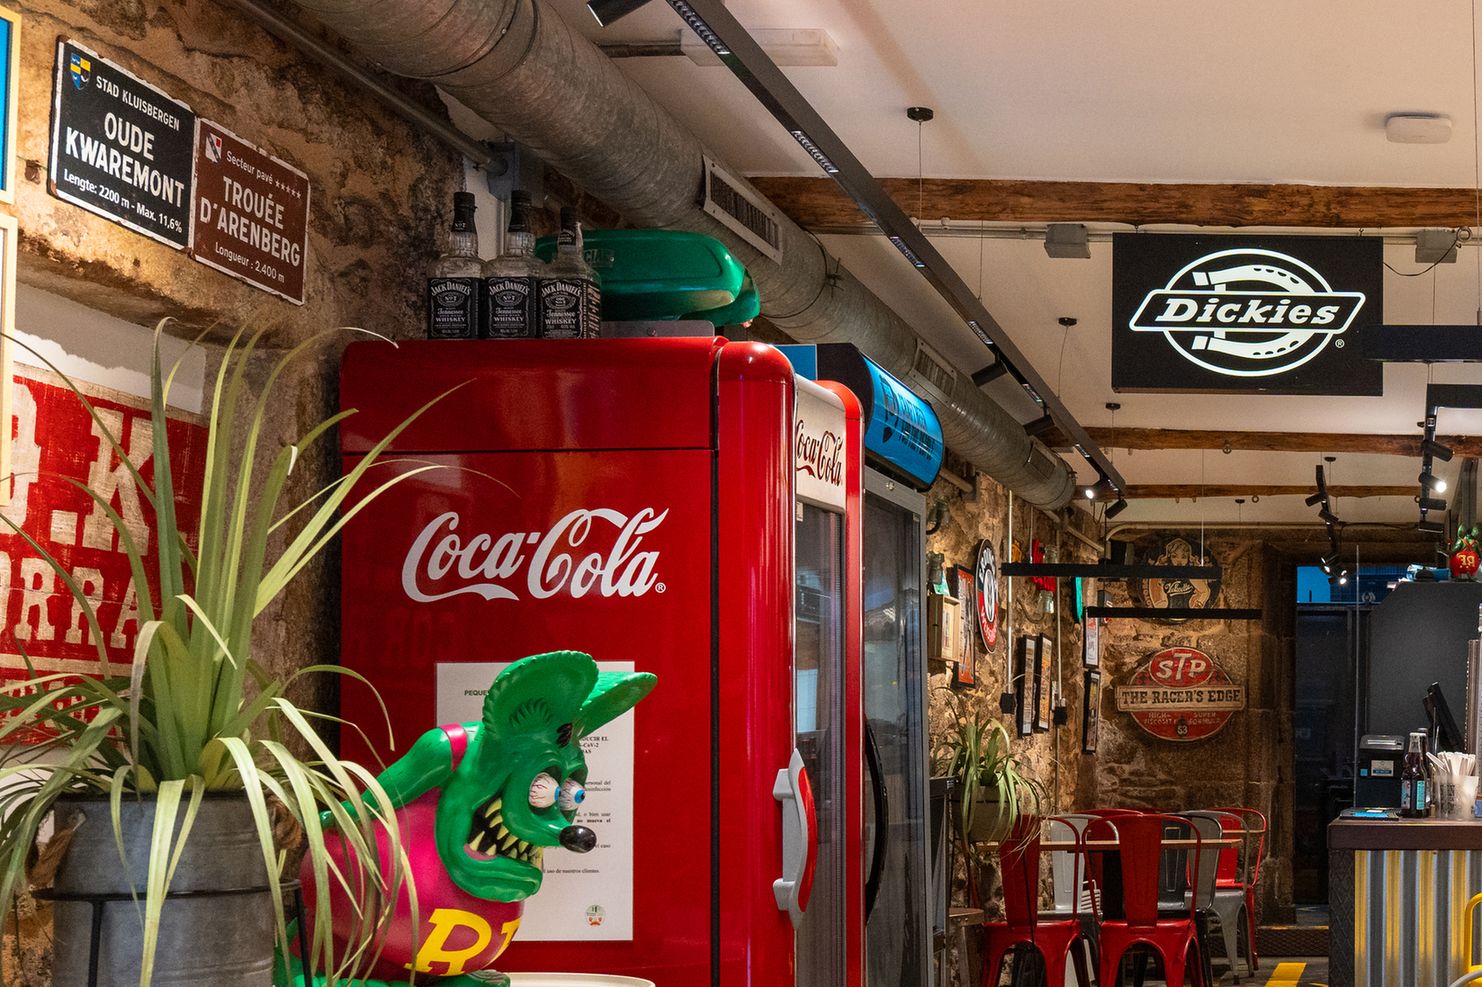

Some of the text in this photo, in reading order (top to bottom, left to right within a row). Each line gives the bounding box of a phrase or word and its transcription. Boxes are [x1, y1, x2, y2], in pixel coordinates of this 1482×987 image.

[96, 75, 180, 131] STAD KLUISBERGEN
[104, 112, 155, 161] OUDE
[65, 127, 185, 208] KWAREMONT
[226, 151, 273, 187] Secteur pavé
[64, 168, 98, 195] Lengte:
[99, 184, 120, 205] 2200
[121, 197, 130, 209] m
[136, 205, 157, 222] Max.
[158, 212, 183, 234] 11,6%
[223, 175, 284, 230] TROUÉE
[215, 241, 249, 268] Longueur
[255, 261, 277, 281] 2.400
[277, 273, 285, 284] m
[1154, 297, 1340, 325] Dickies
[402, 507, 669, 603] Coca-Cola
[1156, 653, 1206, 680] STP
[1122, 689, 1241, 704] THE RACER'S EDGE
